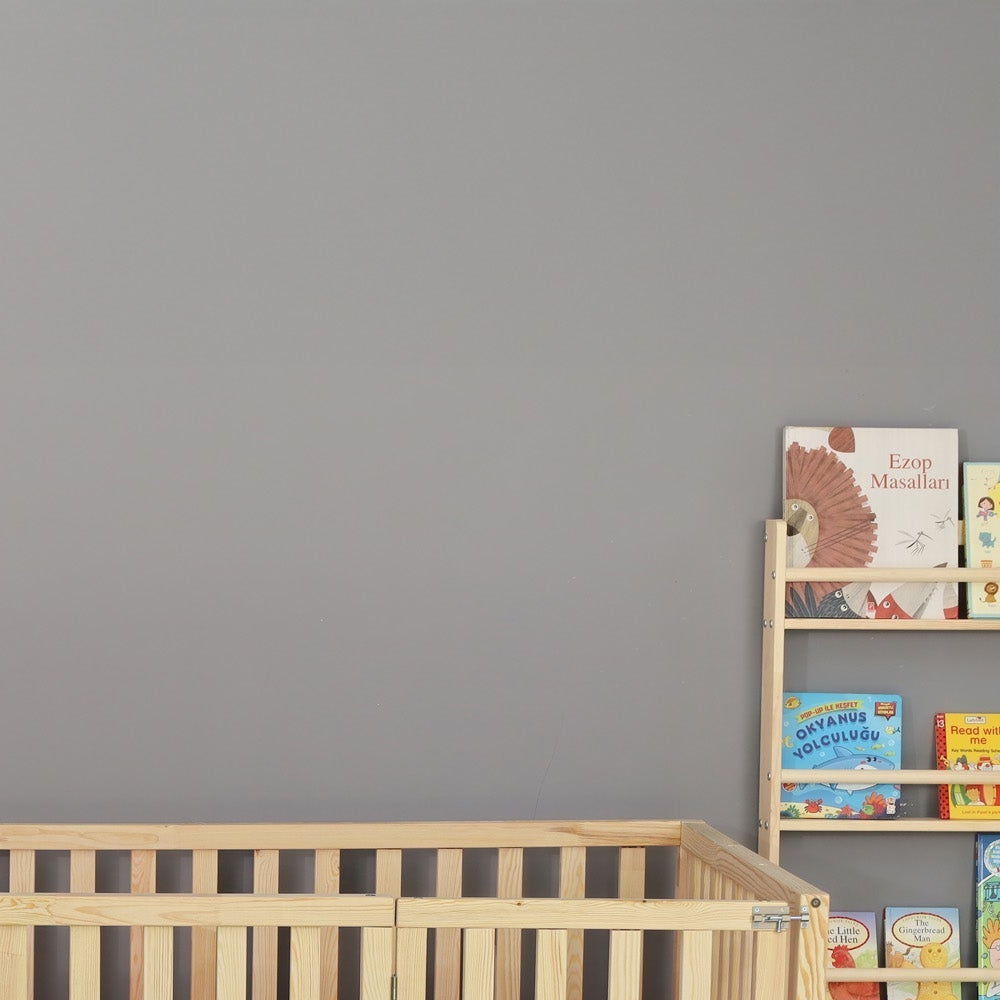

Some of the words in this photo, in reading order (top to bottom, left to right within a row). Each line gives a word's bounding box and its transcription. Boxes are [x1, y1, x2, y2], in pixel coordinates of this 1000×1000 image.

[889, 454, 932, 473] Ezop
[871, 474, 950, 490] Masalları
[800, 707, 823, 719] POP-UP
[796, 711, 867, 740] OKYANUS
[937, 719, 945, 728] 13
[951, 726, 980, 735] Read
[793, 727, 880, 760] YOLCULUĞU
[970, 737, 987, 745] me
[837, 926, 860, 935] Little
[898, 927, 945, 936] Gingerbread
[828, 935, 838, 944] ed
[840, 935, 858, 944] Hen
